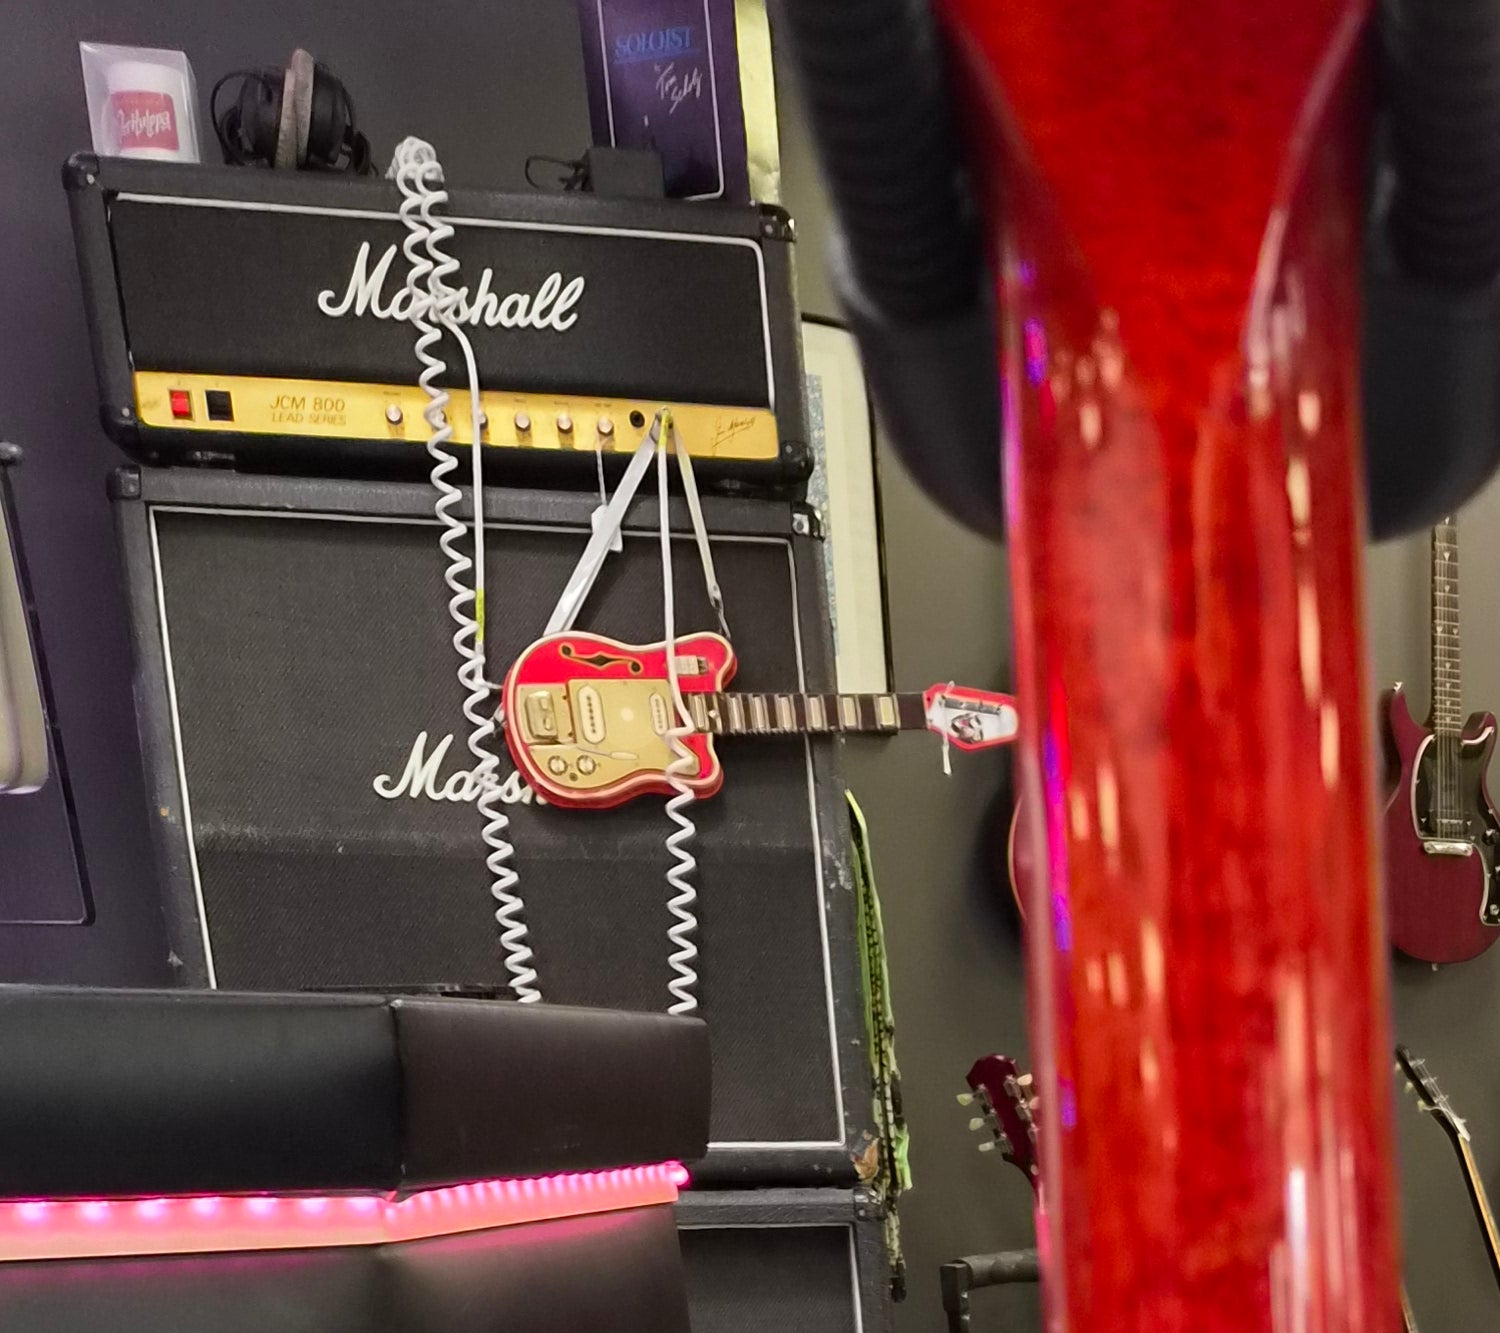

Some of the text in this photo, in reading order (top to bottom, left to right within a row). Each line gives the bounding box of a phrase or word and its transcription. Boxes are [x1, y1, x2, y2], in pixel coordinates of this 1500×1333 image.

[317, 241, 586, 332] Marshall
[270, 395, 346, 412] JCM 800
[271, 412, 347, 425] LEAD SERIES
